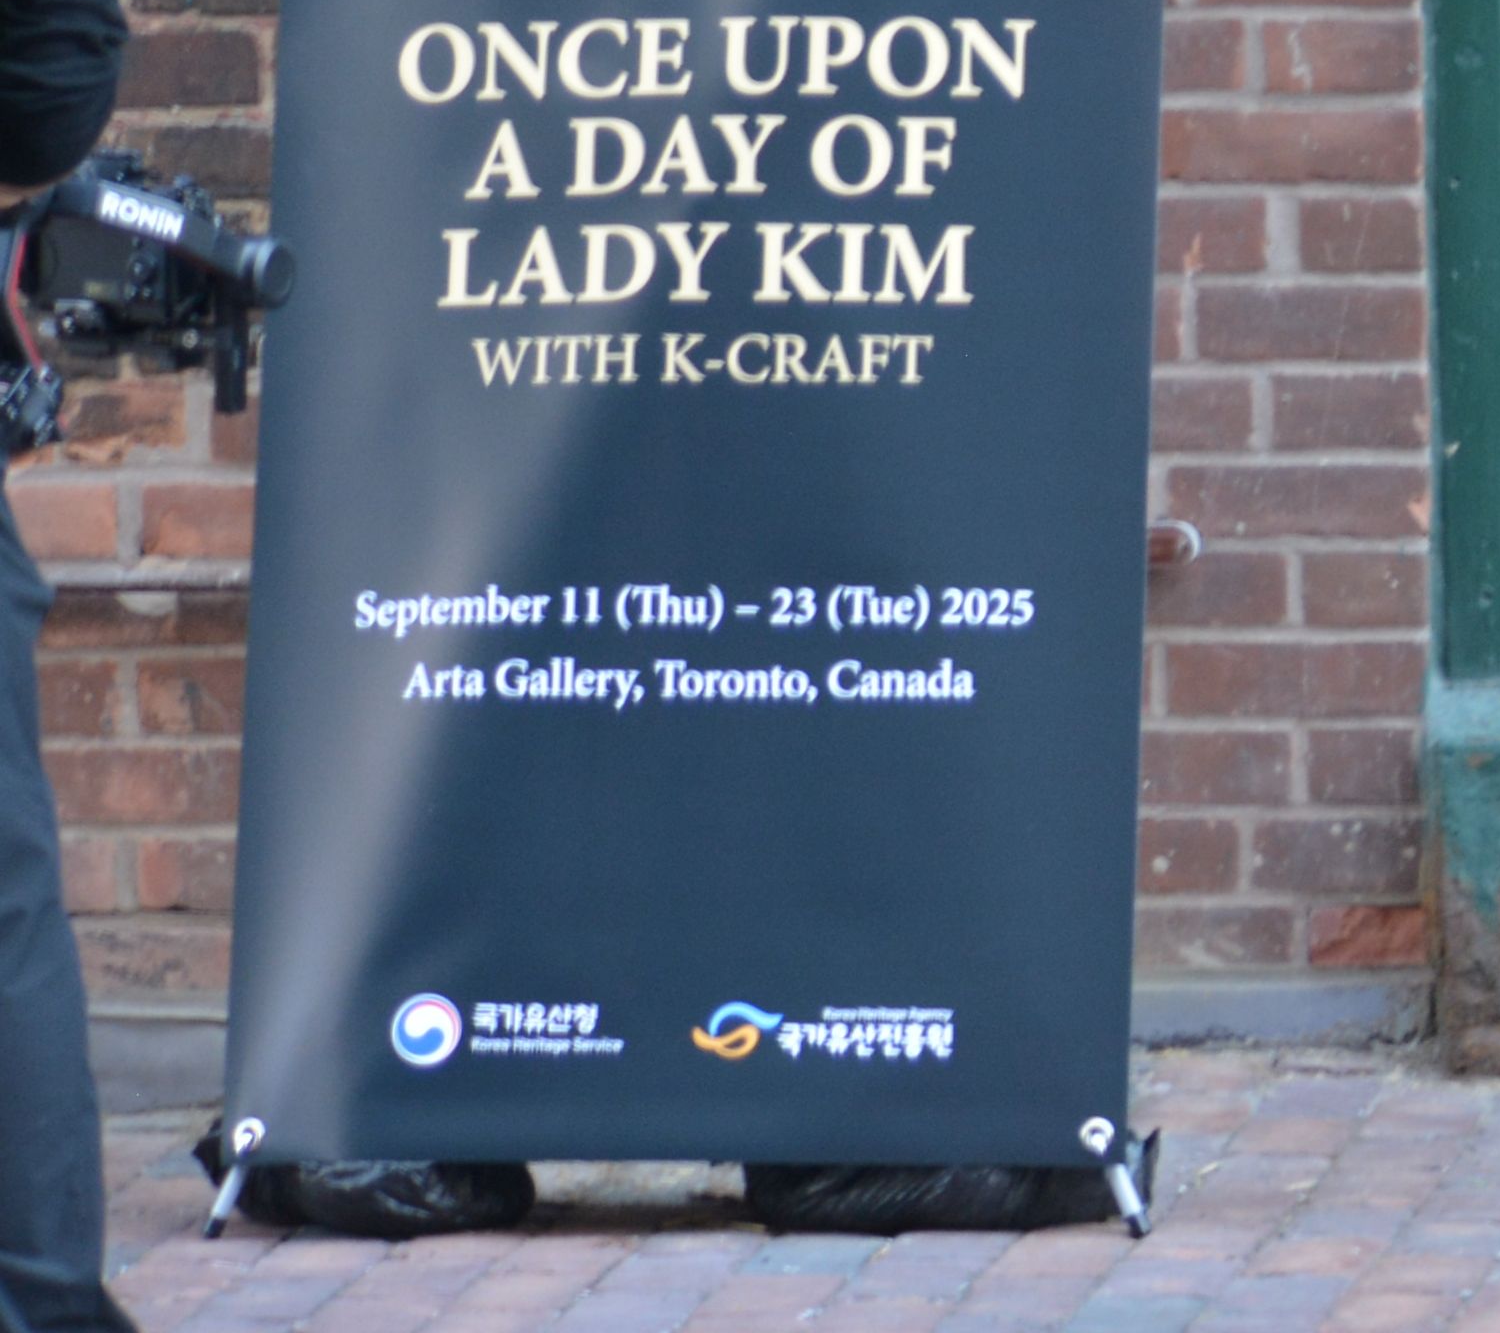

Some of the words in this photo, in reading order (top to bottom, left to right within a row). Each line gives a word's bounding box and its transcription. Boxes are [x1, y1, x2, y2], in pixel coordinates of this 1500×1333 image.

[397, 17, 694, 104] ONCE
[720, 15, 1036, 100] UPON
[463, 117, 542, 200] A
[564, 113, 788, 199] DAY
[809, 113, 958, 198] OF
[99, 188, 186, 242] RONIN
[437, 221, 730, 309] LADY
[752, 221, 976, 306] KIM
[471, 333, 641, 388] WITH
[659, 332, 934, 385] K-CRAFT
[354, 583, 549, 638] September
[561, 586, 601, 625] 11
[614, 582, 725, 632] (Thu)
[769, 586, 818, 626] 23
[826, 583, 930, 632] (Tue)
[940, 586, 1036, 628] 2025
[401, 660, 485, 701] Arta
[494, 656, 644, 711] Gallery,
[656, 658, 818, 704] Toronto,
[826, 657, 976, 700] Canada
[471, 1002, 600, 1035] 국가유산청
[776, 1022, 955, 1060] 국가유산진흥원
[511, 1037, 570, 1057] Heritage
[572, 1037, 625, 1056] Service
